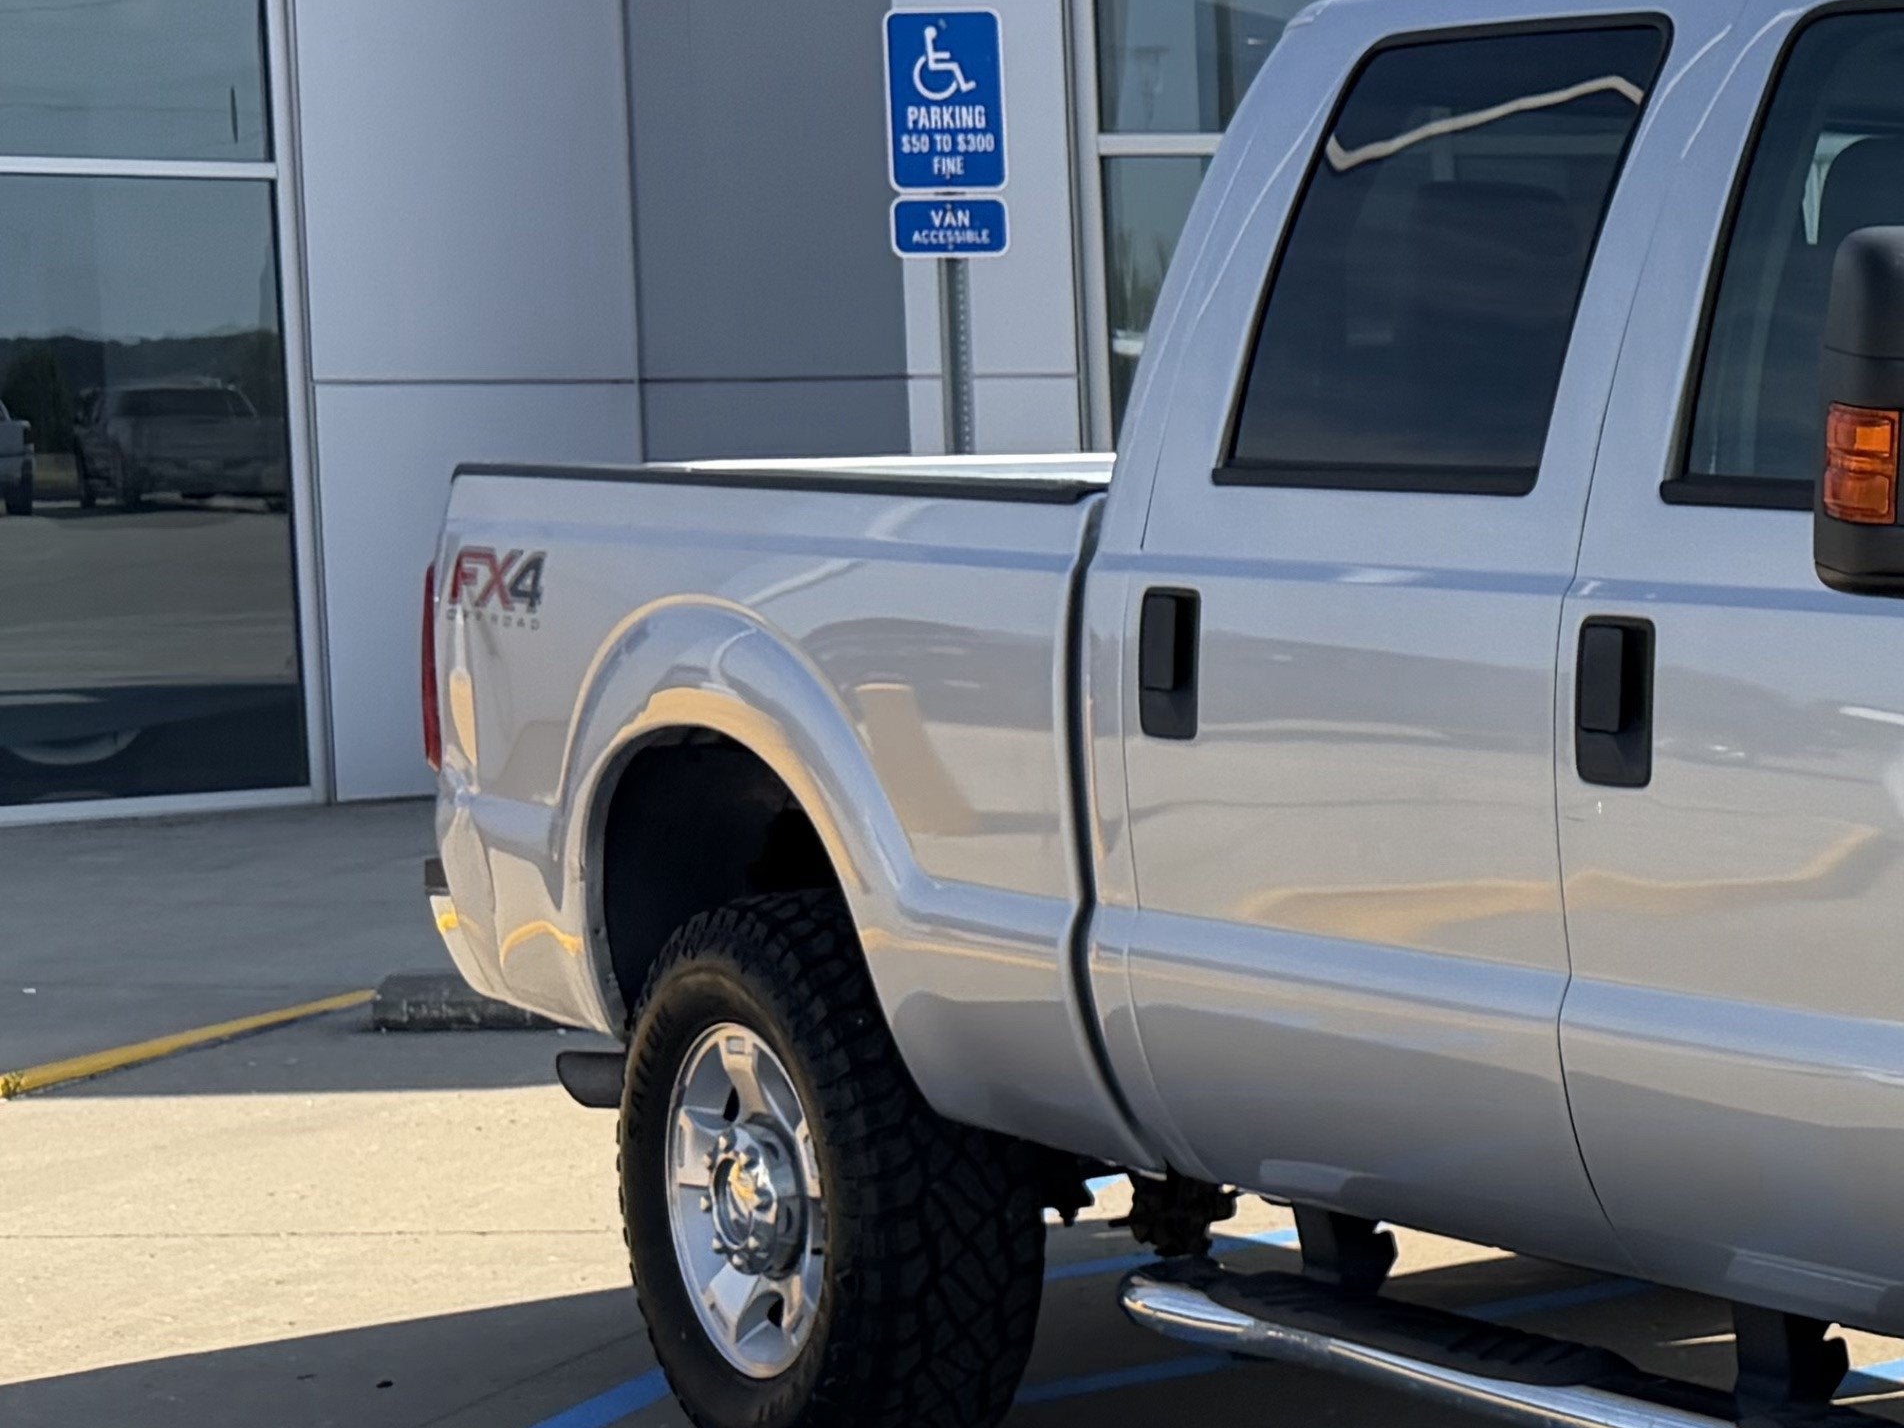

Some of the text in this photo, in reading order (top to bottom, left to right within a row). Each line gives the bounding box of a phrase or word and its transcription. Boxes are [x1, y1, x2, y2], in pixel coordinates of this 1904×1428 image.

[907, 105, 986, 130] PARKING
[901, 133, 995, 154] $50 TO $300
[932, 155, 965, 176] FINE
[930, 209, 971, 227] VAN
[911, 229, 991, 245] ACCESSIBLE
[449, 545, 548, 613] FX4
